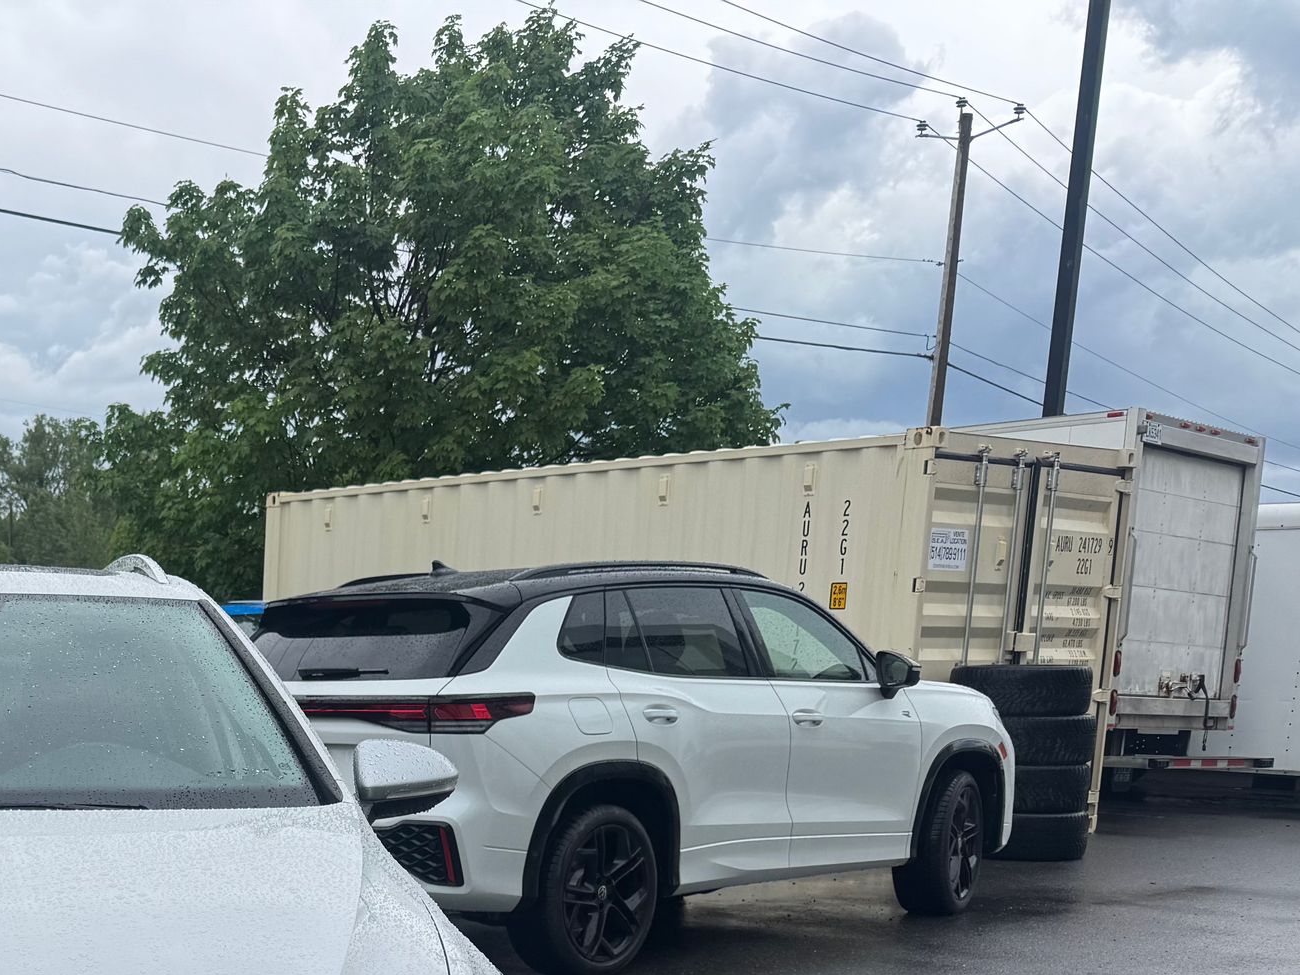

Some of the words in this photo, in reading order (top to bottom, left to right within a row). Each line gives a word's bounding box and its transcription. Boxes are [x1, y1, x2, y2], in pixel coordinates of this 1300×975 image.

[798, 501, 811, 575] AURU
[839, 499, 851, 576] 22G1
[1055, 535, 1074, 552] AURU
[1078, 537, 1102, 553] 241729
[1107, 538, 1114, 555] 9
[1075, 558, 1092, 575] 22G1
